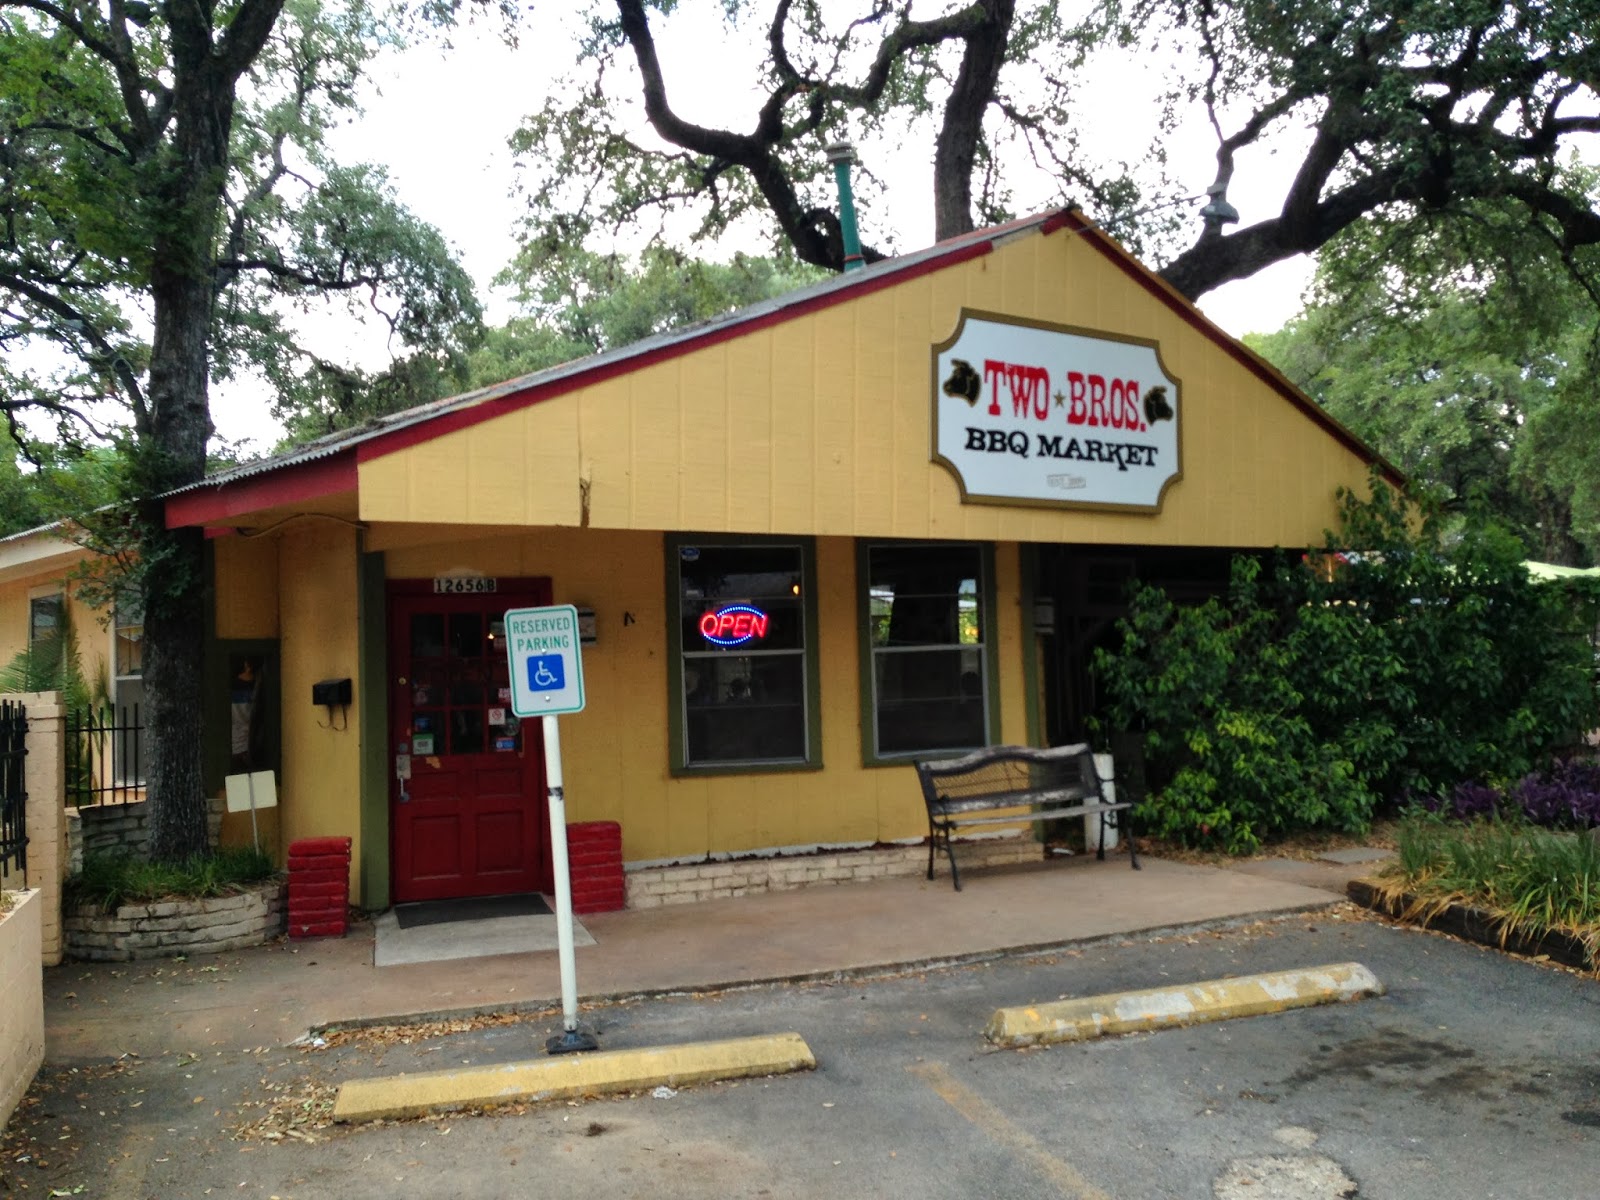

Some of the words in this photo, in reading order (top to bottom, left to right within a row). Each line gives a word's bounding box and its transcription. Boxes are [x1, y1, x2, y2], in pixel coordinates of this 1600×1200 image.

[984, 359, 1049, 421] TWO
[1067, 371, 1146, 432] BROS.
[965, 427, 1029, 458] BBQ
[1037, 434, 1158, 471] MARKET
[513, 617, 570, 634] RESERVED
[701, 613, 768, 638] OPEN
[517, 635, 569, 651] PARKING
